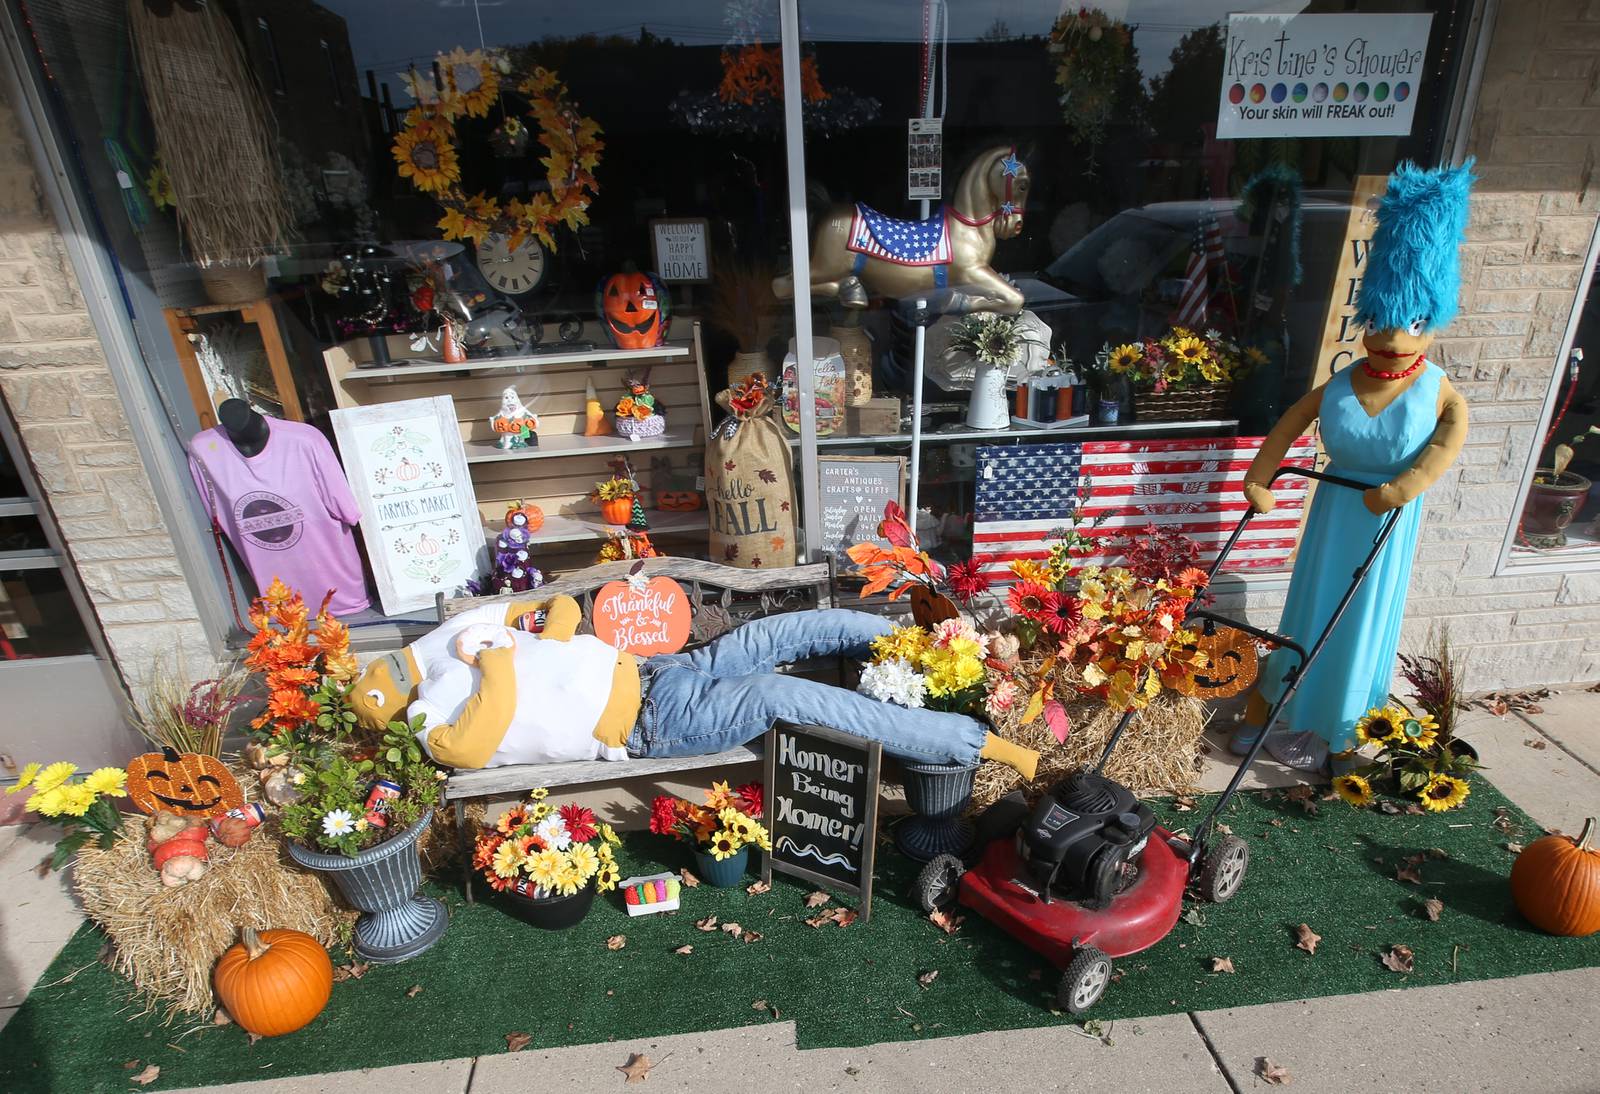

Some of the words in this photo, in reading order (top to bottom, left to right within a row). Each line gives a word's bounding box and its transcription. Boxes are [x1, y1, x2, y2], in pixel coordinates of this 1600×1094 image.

[1344, 37, 1423, 78] Shower
[1239, 106, 1270, 119] Your
[1272, 106, 1297, 119] skin
[1302, 105, 1323, 119] will
[1327, 105, 1367, 118] FREAK
[1369, 104, 1396, 118] out!
[668, 243, 694, 254] HAPPY
[663, 262, 703, 279] HOME
[825, 467, 859, 476] CARTER'S
[864, 486, 889, 494] GIFTS
[378, 499, 419, 521] FARMERS
[420, 493, 455, 513] MARKET
[711, 497, 777, 536] FALL
[602, 588, 676, 620] Thankful
[636, 612, 649, 627] &
[614, 622, 670, 651] Blessed
[779, 733, 864, 784] Homer
[791, 772, 854, 819] Being
